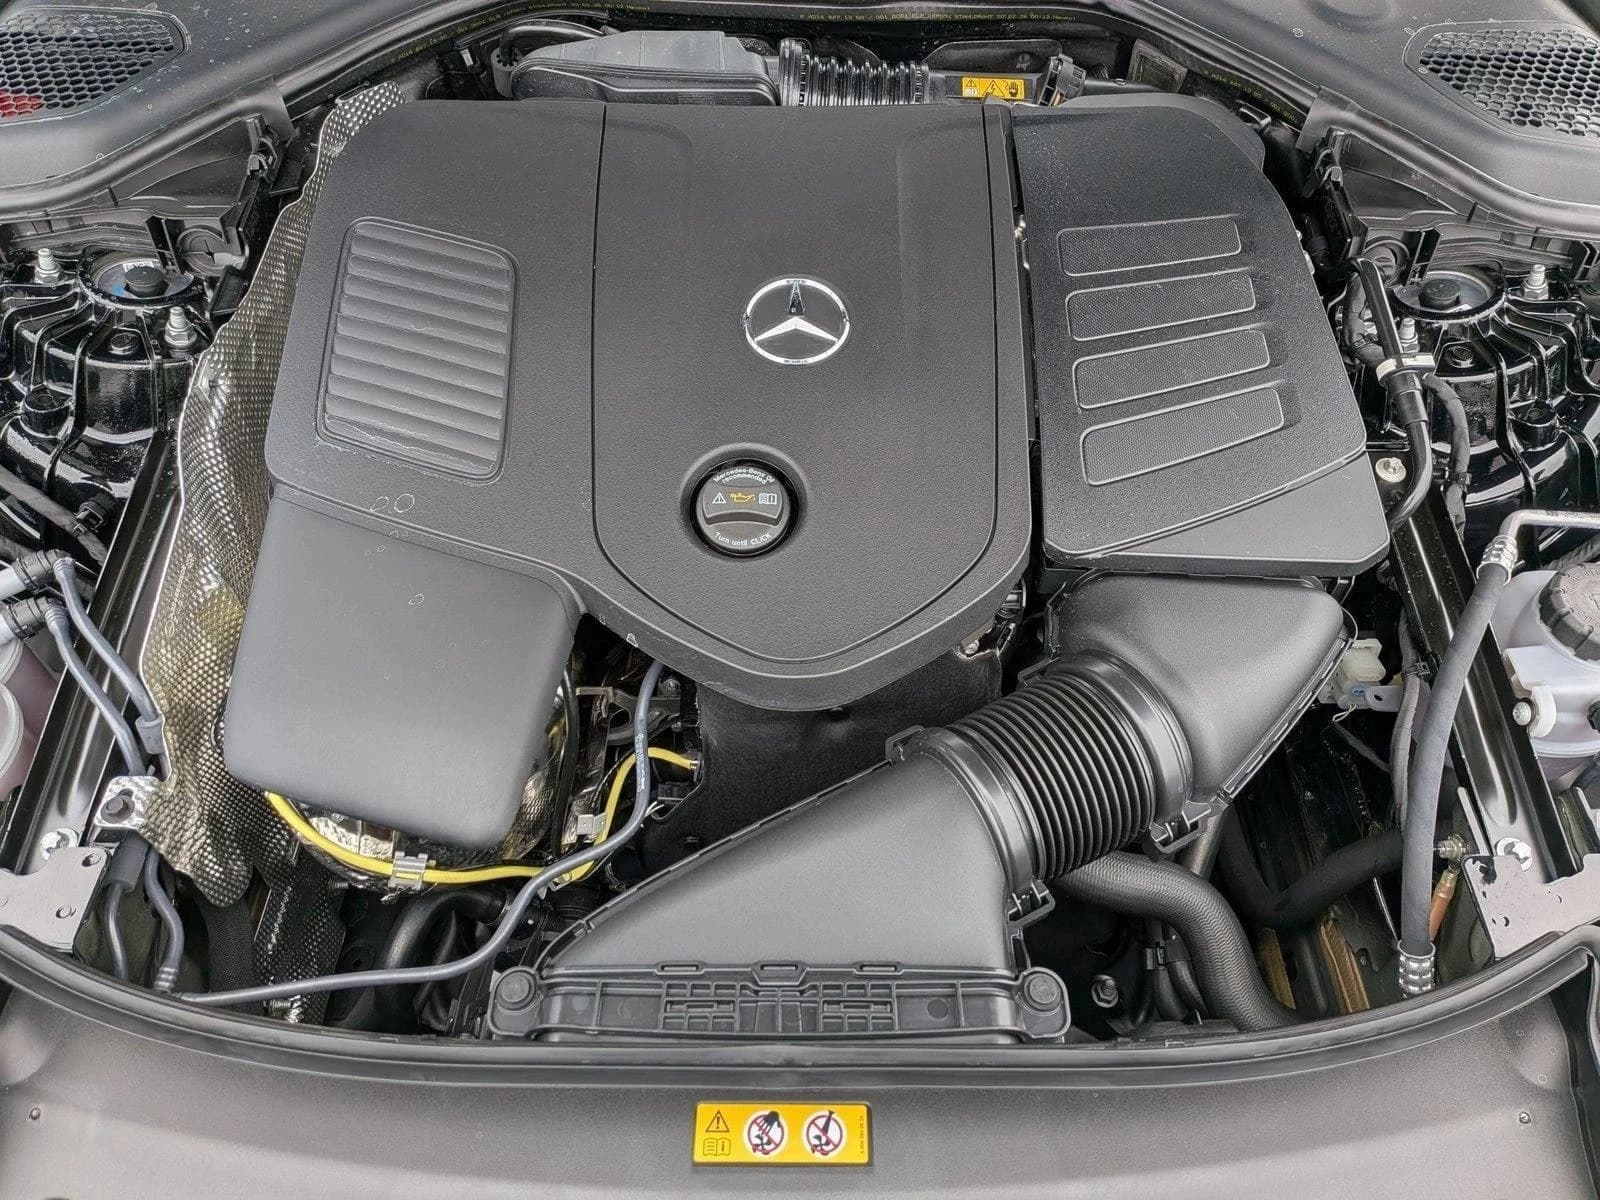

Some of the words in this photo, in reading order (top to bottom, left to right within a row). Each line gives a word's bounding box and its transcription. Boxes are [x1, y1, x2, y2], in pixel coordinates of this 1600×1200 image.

[713, 468, 766, 482] Mercedes-Benz
[722, 473, 767, 485] recommended
[715, 531, 730, 544] Turn
[751, 532, 772, 546] CLICK
